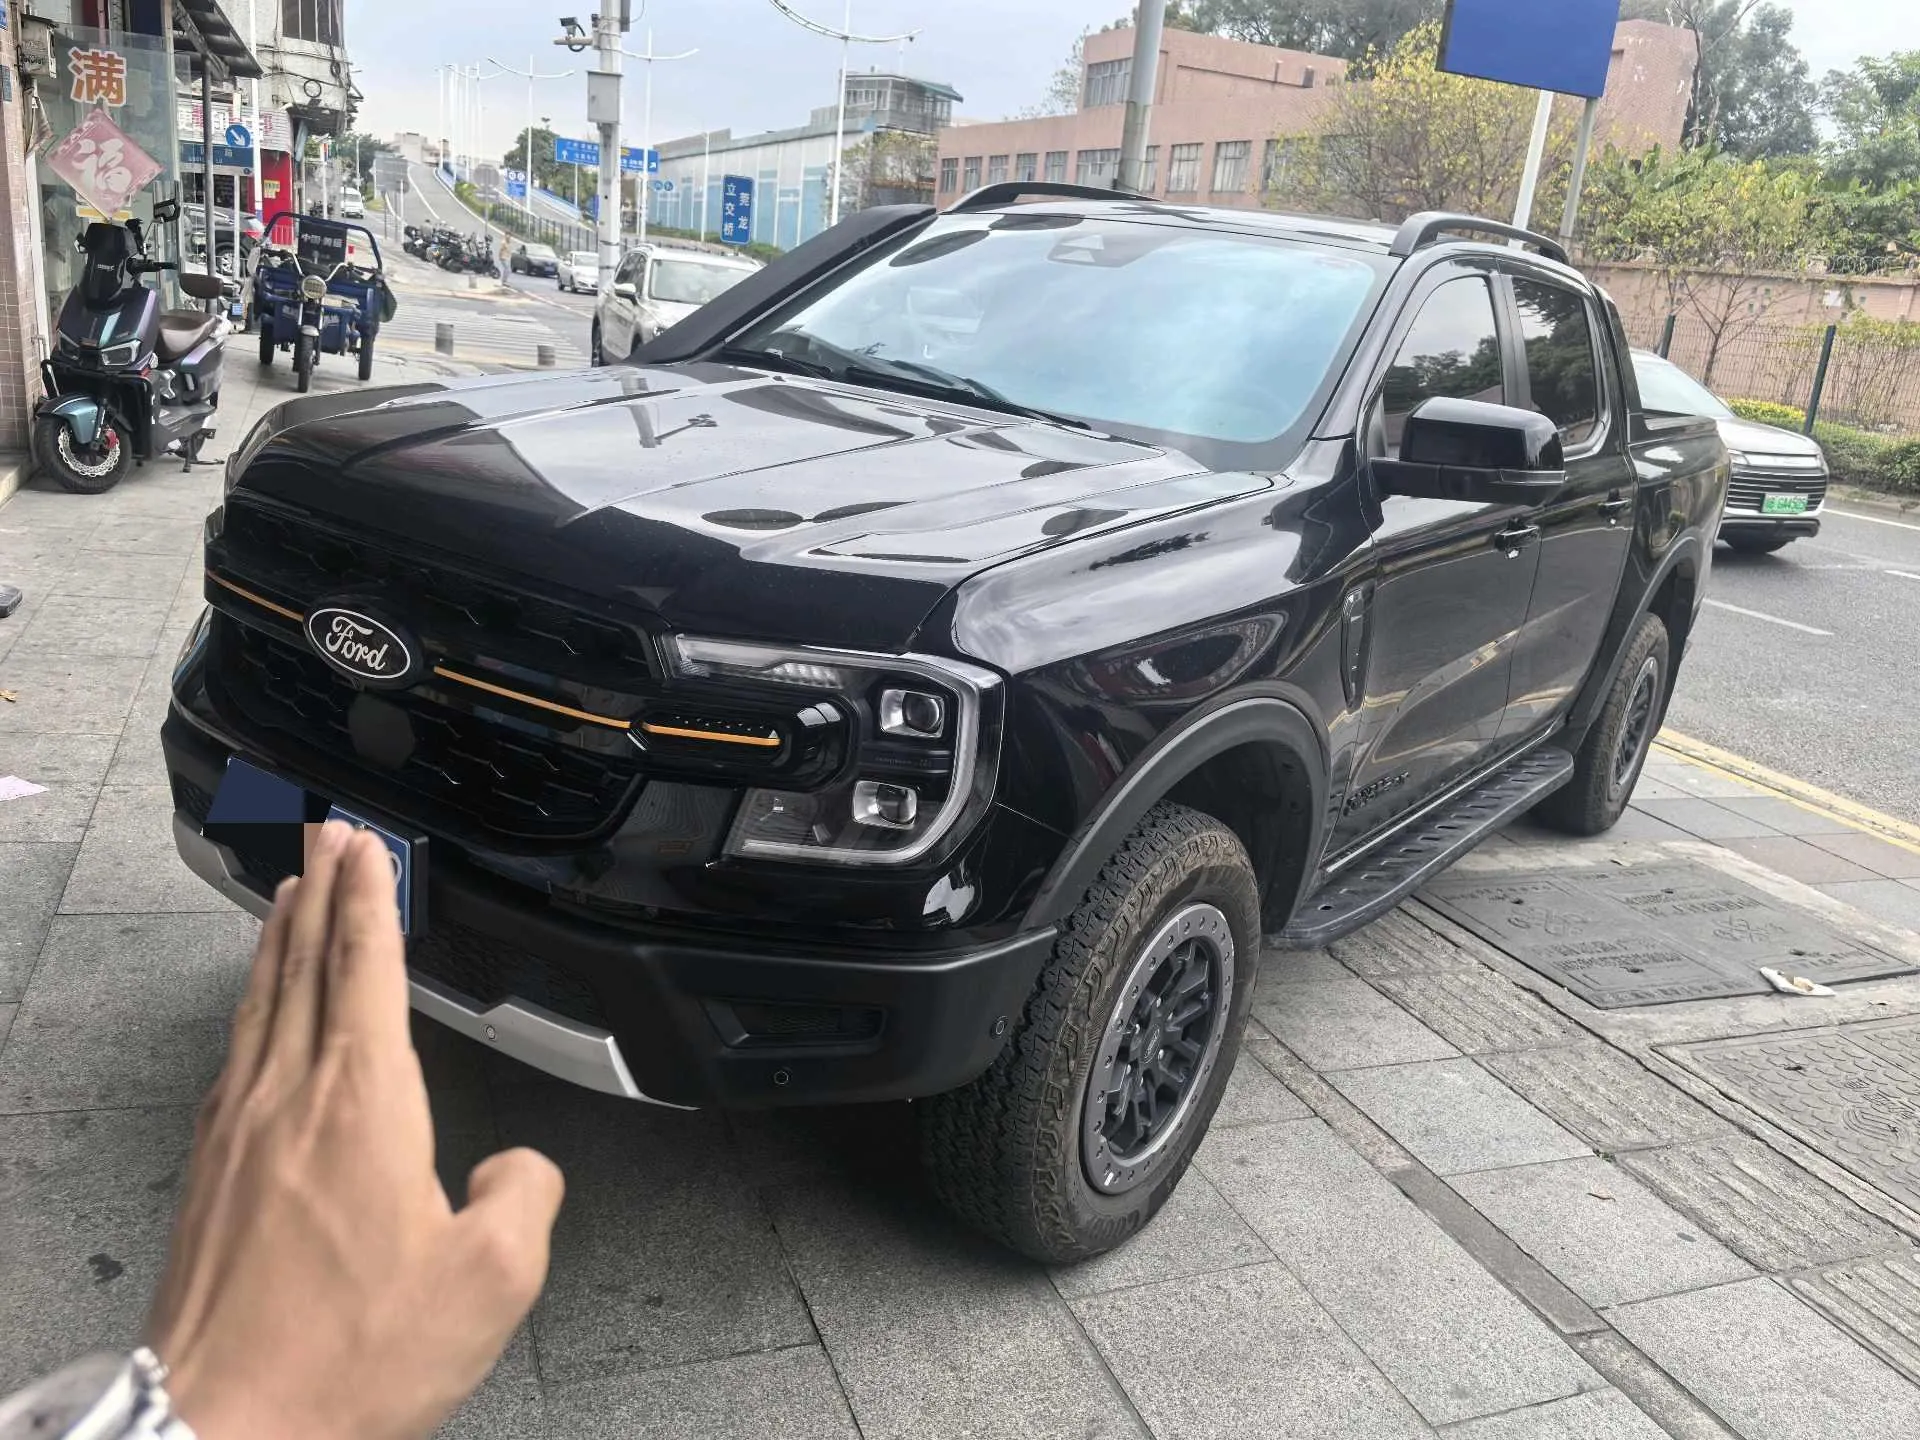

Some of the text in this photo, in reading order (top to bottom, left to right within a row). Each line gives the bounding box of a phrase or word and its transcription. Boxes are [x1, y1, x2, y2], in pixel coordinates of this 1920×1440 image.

[70, 48, 126, 107] 满
[72, 139, 132, 193] 福
[725, 184, 737, 236] 立交桥
[325, 616, 389, 670] Ford
